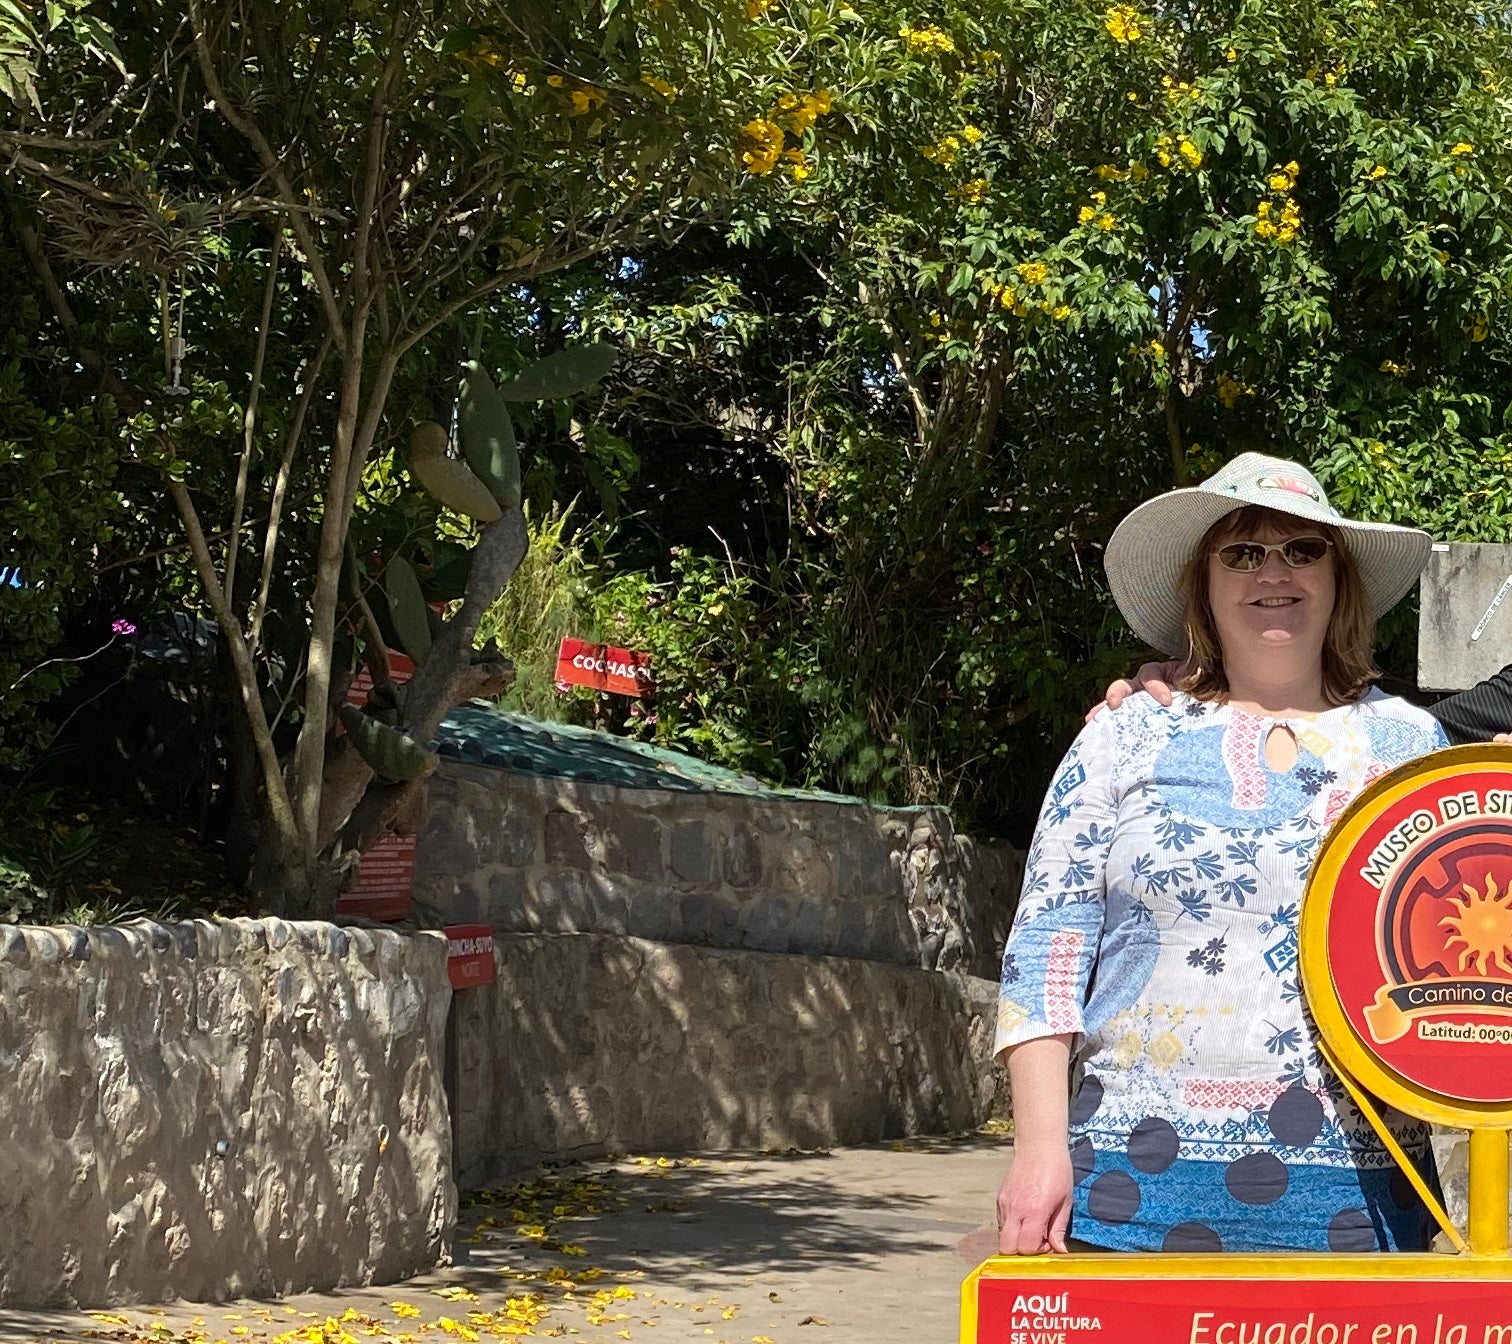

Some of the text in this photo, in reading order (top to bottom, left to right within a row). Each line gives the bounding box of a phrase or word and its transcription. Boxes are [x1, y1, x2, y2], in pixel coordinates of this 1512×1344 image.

[1364, 812, 1434, 885] MUSEO
[1443, 794, 1477, 820] DE
[1408, 984, 1486, 1004] Camino
[1422, 1025, 1476, 1039] Latitud:
[1011, 1291, 1070, 1316] AQUÍ
[1011, 1317, 1102, 1330] LA CULTURA
